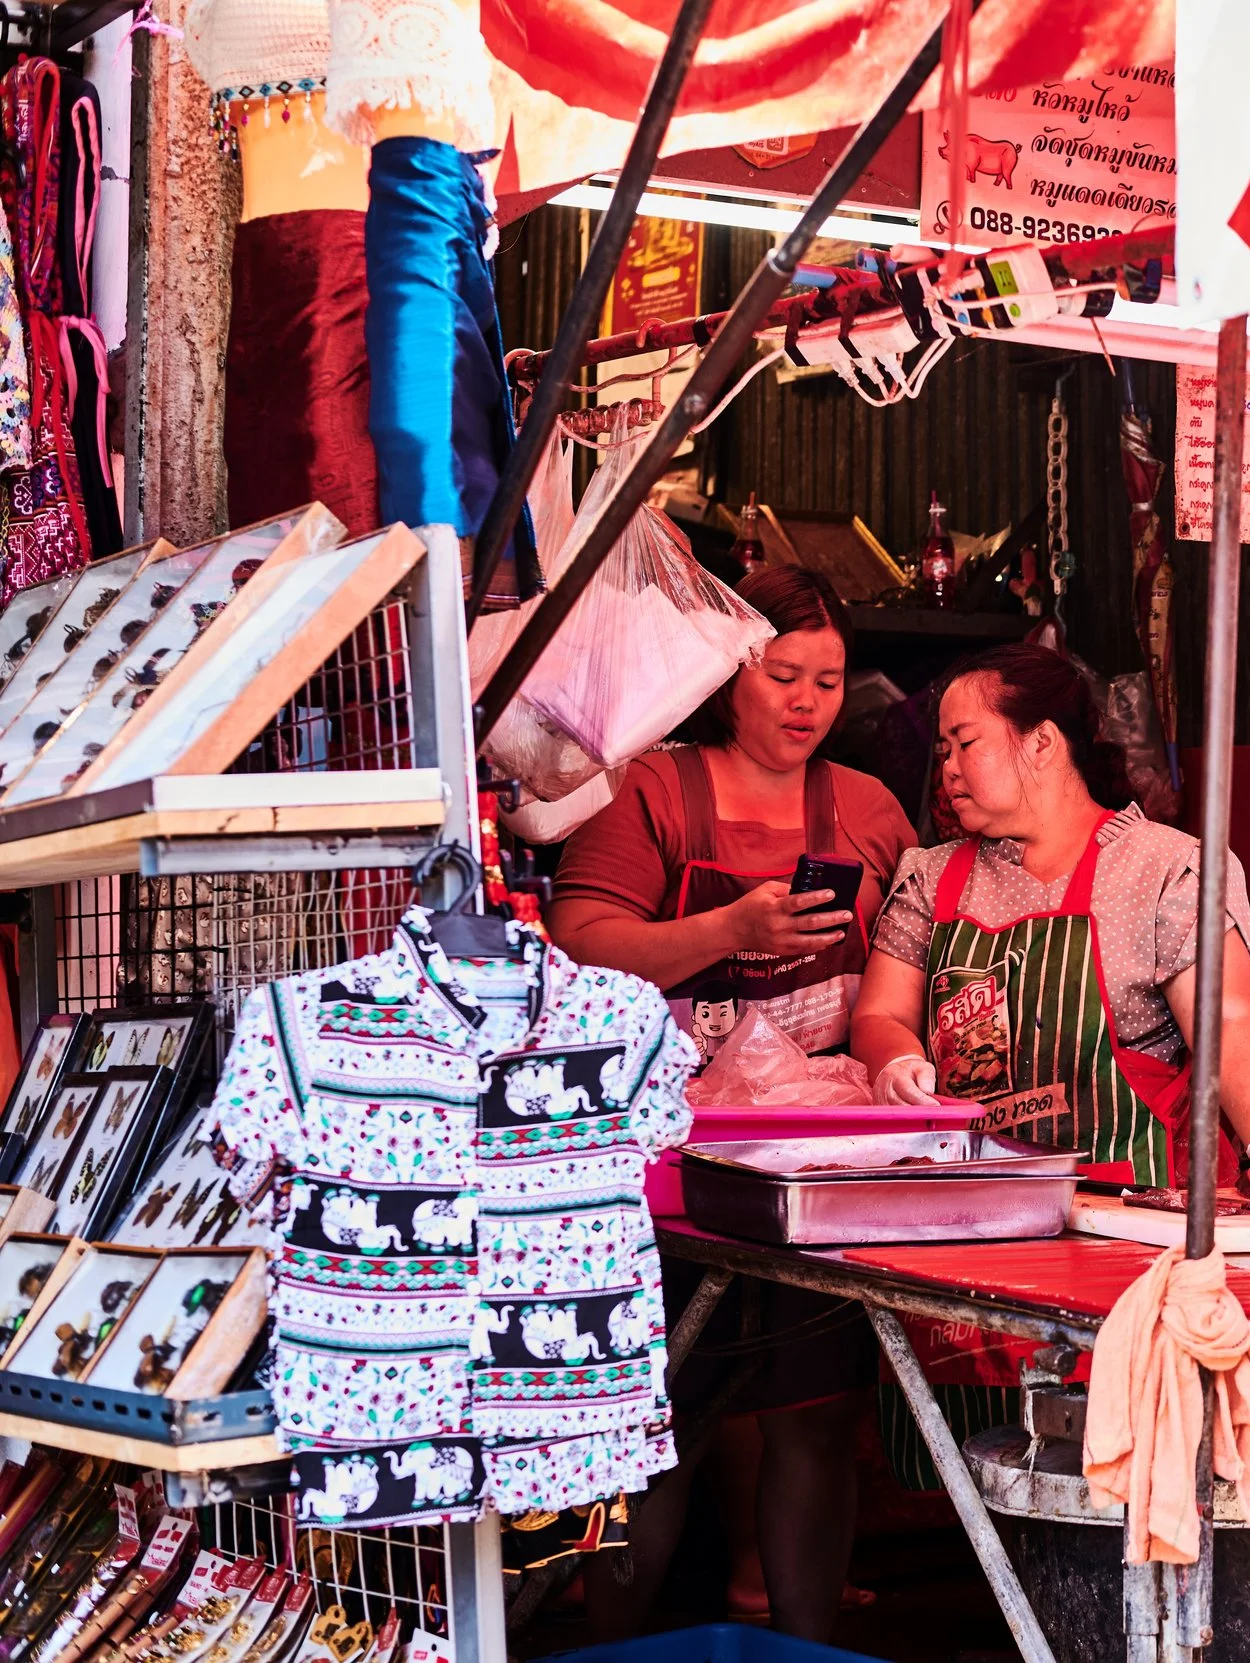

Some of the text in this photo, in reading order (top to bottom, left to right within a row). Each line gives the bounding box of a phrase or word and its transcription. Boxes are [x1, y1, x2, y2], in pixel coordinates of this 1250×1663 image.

[1032, 80, 1143, 124] หัวหมูไหว้
[940, 979, 996, 1032] รสดี
[1012, 1093, 1054, 1118] ทอด
